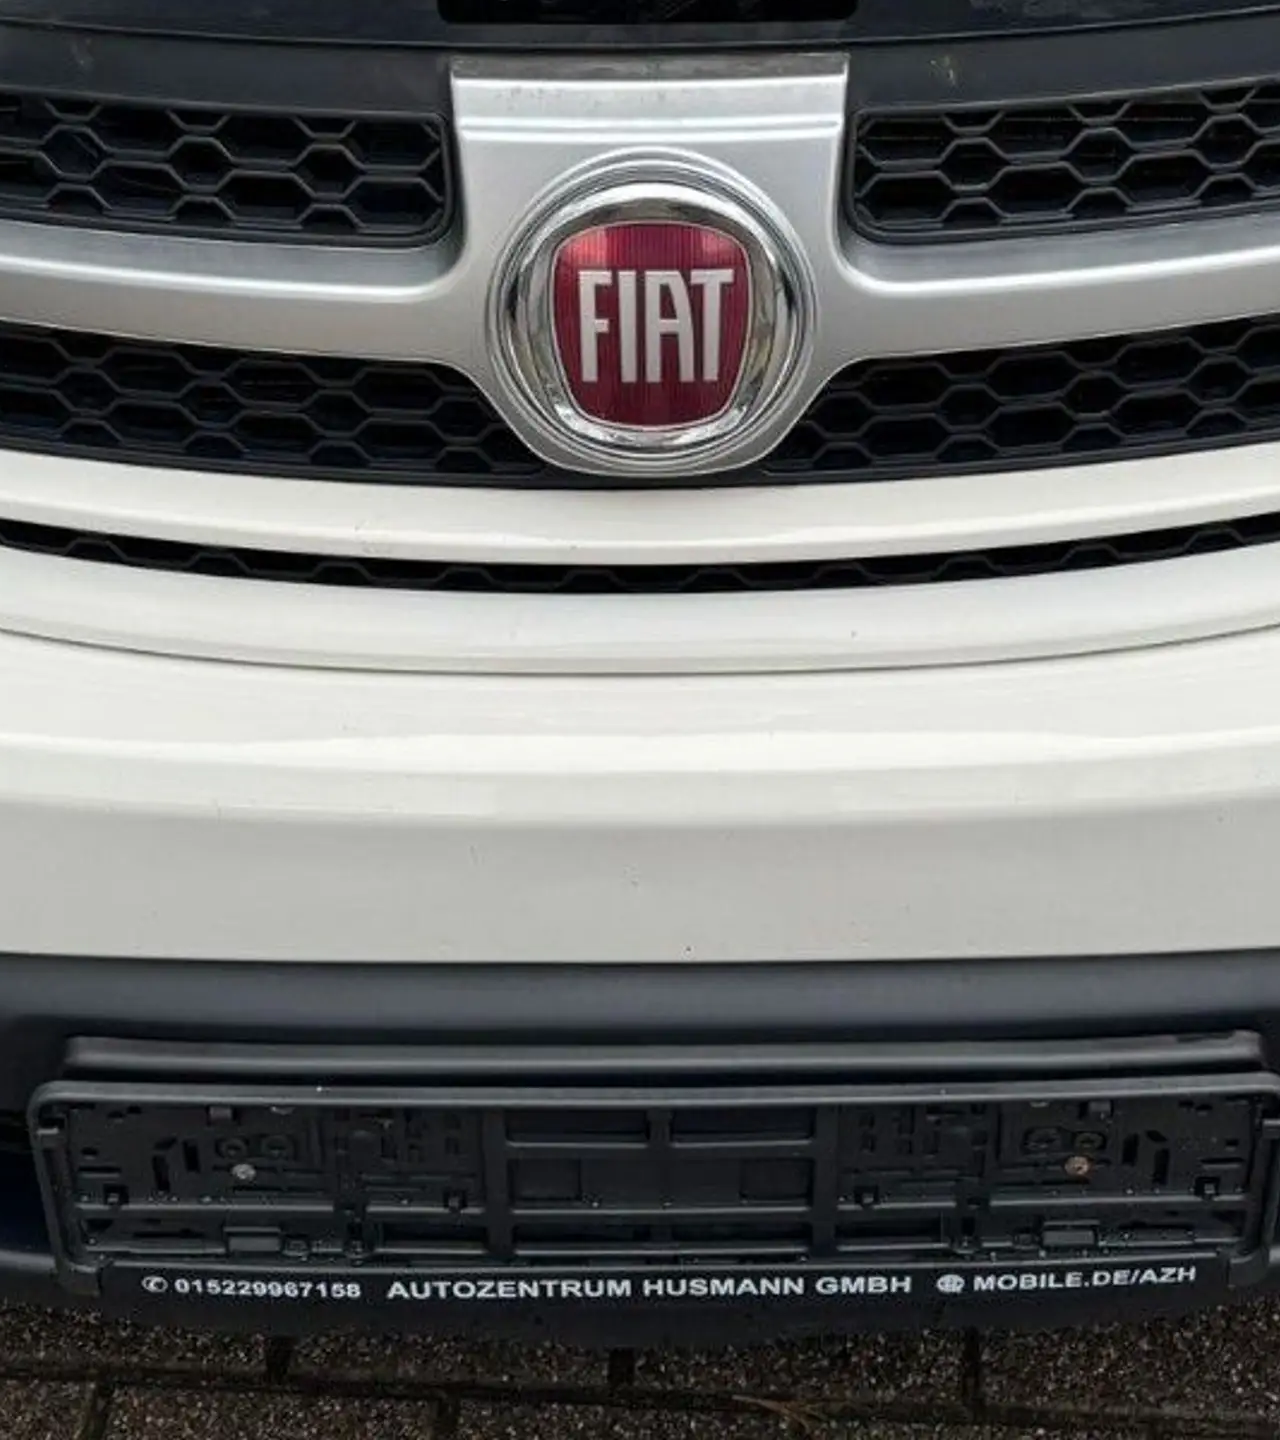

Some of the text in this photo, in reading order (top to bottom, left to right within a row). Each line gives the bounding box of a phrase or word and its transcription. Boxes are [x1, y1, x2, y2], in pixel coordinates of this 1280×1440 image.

[578, 269, 734, 384] FIAT
[386, 1279, 632, 1300] AUTOZENTRUM
[642, 1277, 805, 1297] HUSMANN
[815, 1276, 912, 1295] GMBH
[973, 1266, 1197, 1291] MOBILE.DE/AZH
